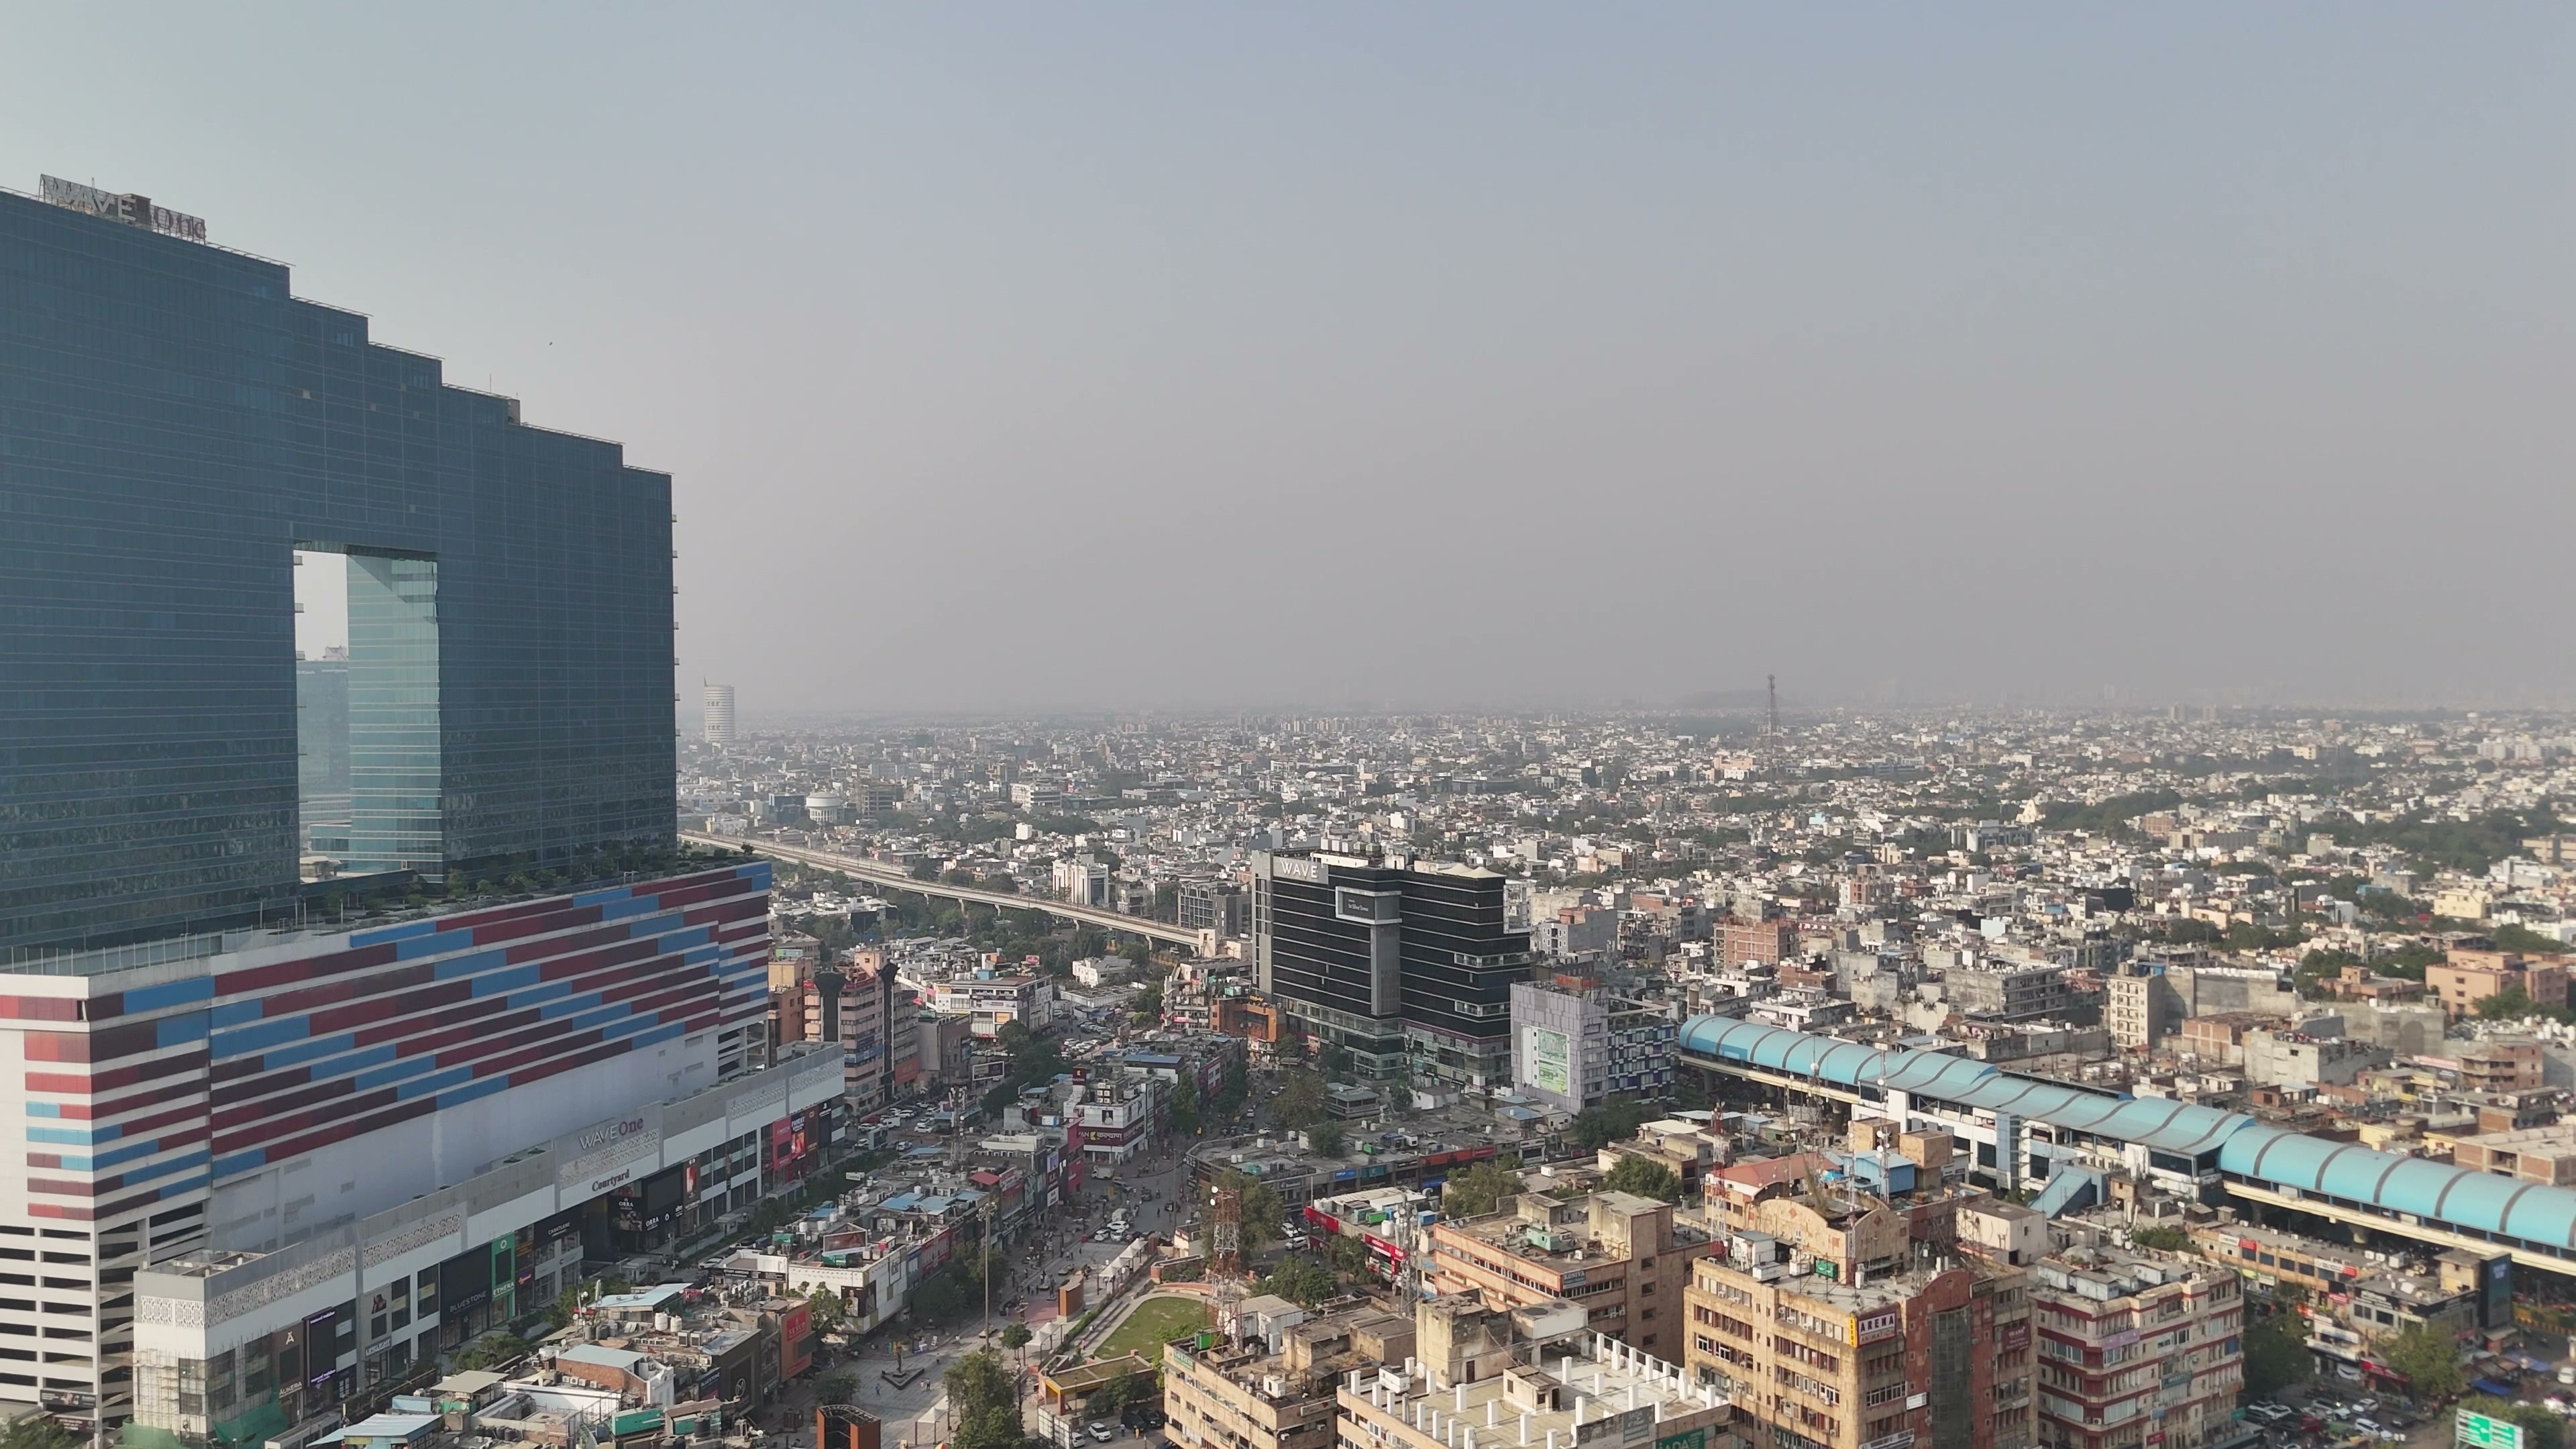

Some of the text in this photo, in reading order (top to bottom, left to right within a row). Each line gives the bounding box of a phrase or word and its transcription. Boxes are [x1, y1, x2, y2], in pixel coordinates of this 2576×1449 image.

[42, 174, 138, 221] WAVE
[1281, 861, 1318, 879] WAVE
[579, 1118, 644, 1150] WAVE One
[592, 1169, 630, 1192] Courtyard
[646, 1216, 659, 1227] ORRA
[493, 1281, 515, 1295] ETHERA
[449, 1290, 487, 1313] BLUESTONE
[1860, 1315, 1894, 1332] ARENA
